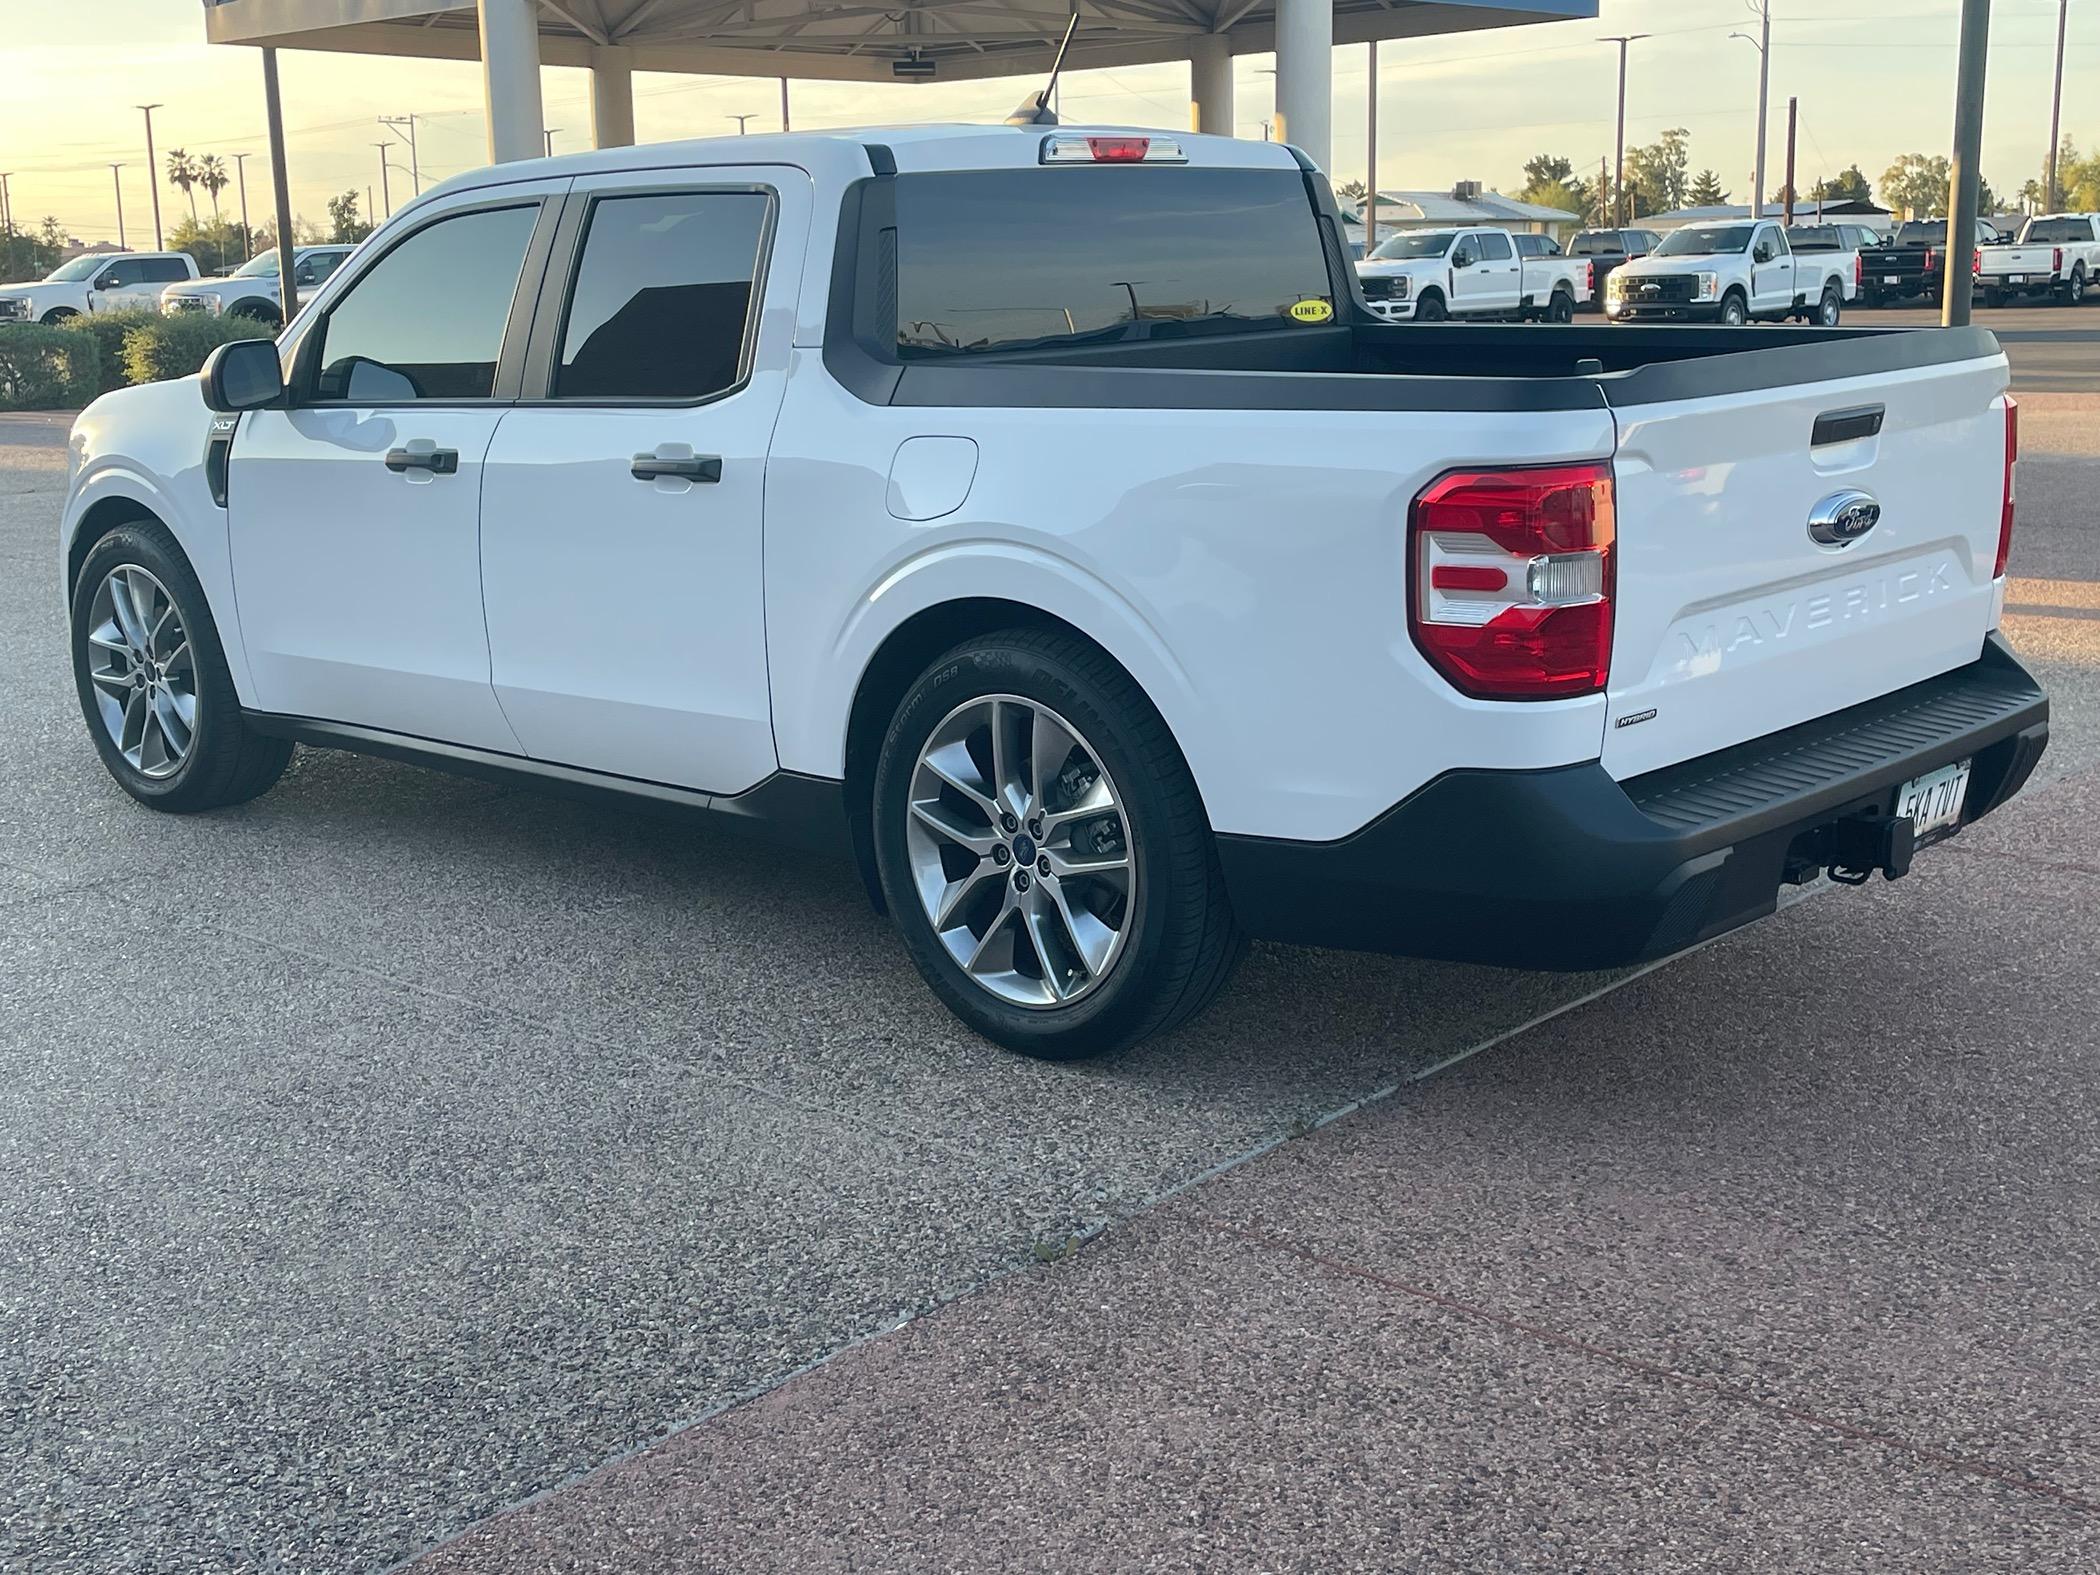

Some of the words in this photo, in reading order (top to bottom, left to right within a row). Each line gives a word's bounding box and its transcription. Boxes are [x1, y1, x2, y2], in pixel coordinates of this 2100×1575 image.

[212, 421, 235, 430] XLT
[1843, 505, 1874, 531] Ford
[1678, 561, 1950, 668] MAVERICK
[1619, 710, 1655, 726] HYBRID
